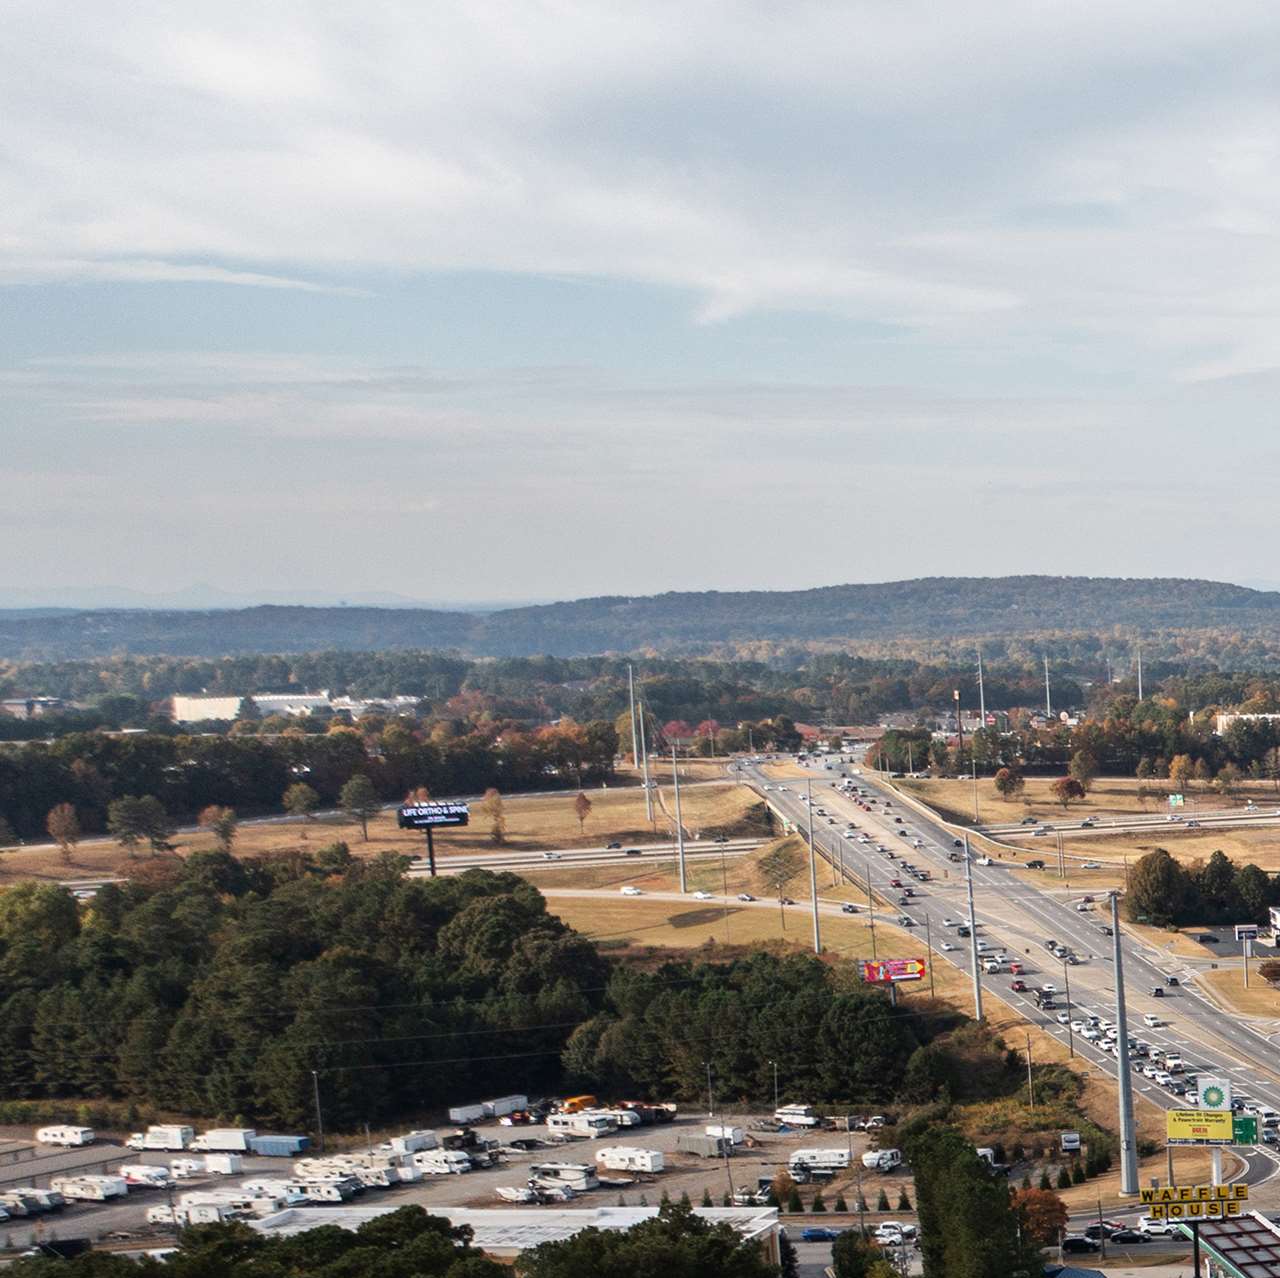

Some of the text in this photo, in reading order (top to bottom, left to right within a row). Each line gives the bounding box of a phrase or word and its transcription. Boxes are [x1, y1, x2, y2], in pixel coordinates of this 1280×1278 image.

[403, 808, 418, 816] LIFE
[418, 807, 442, 815] ORTHO
[1141, 1186, 1245, 1202] WAFFLE
[1152, 1203, 1237, 1217] HOUSE
